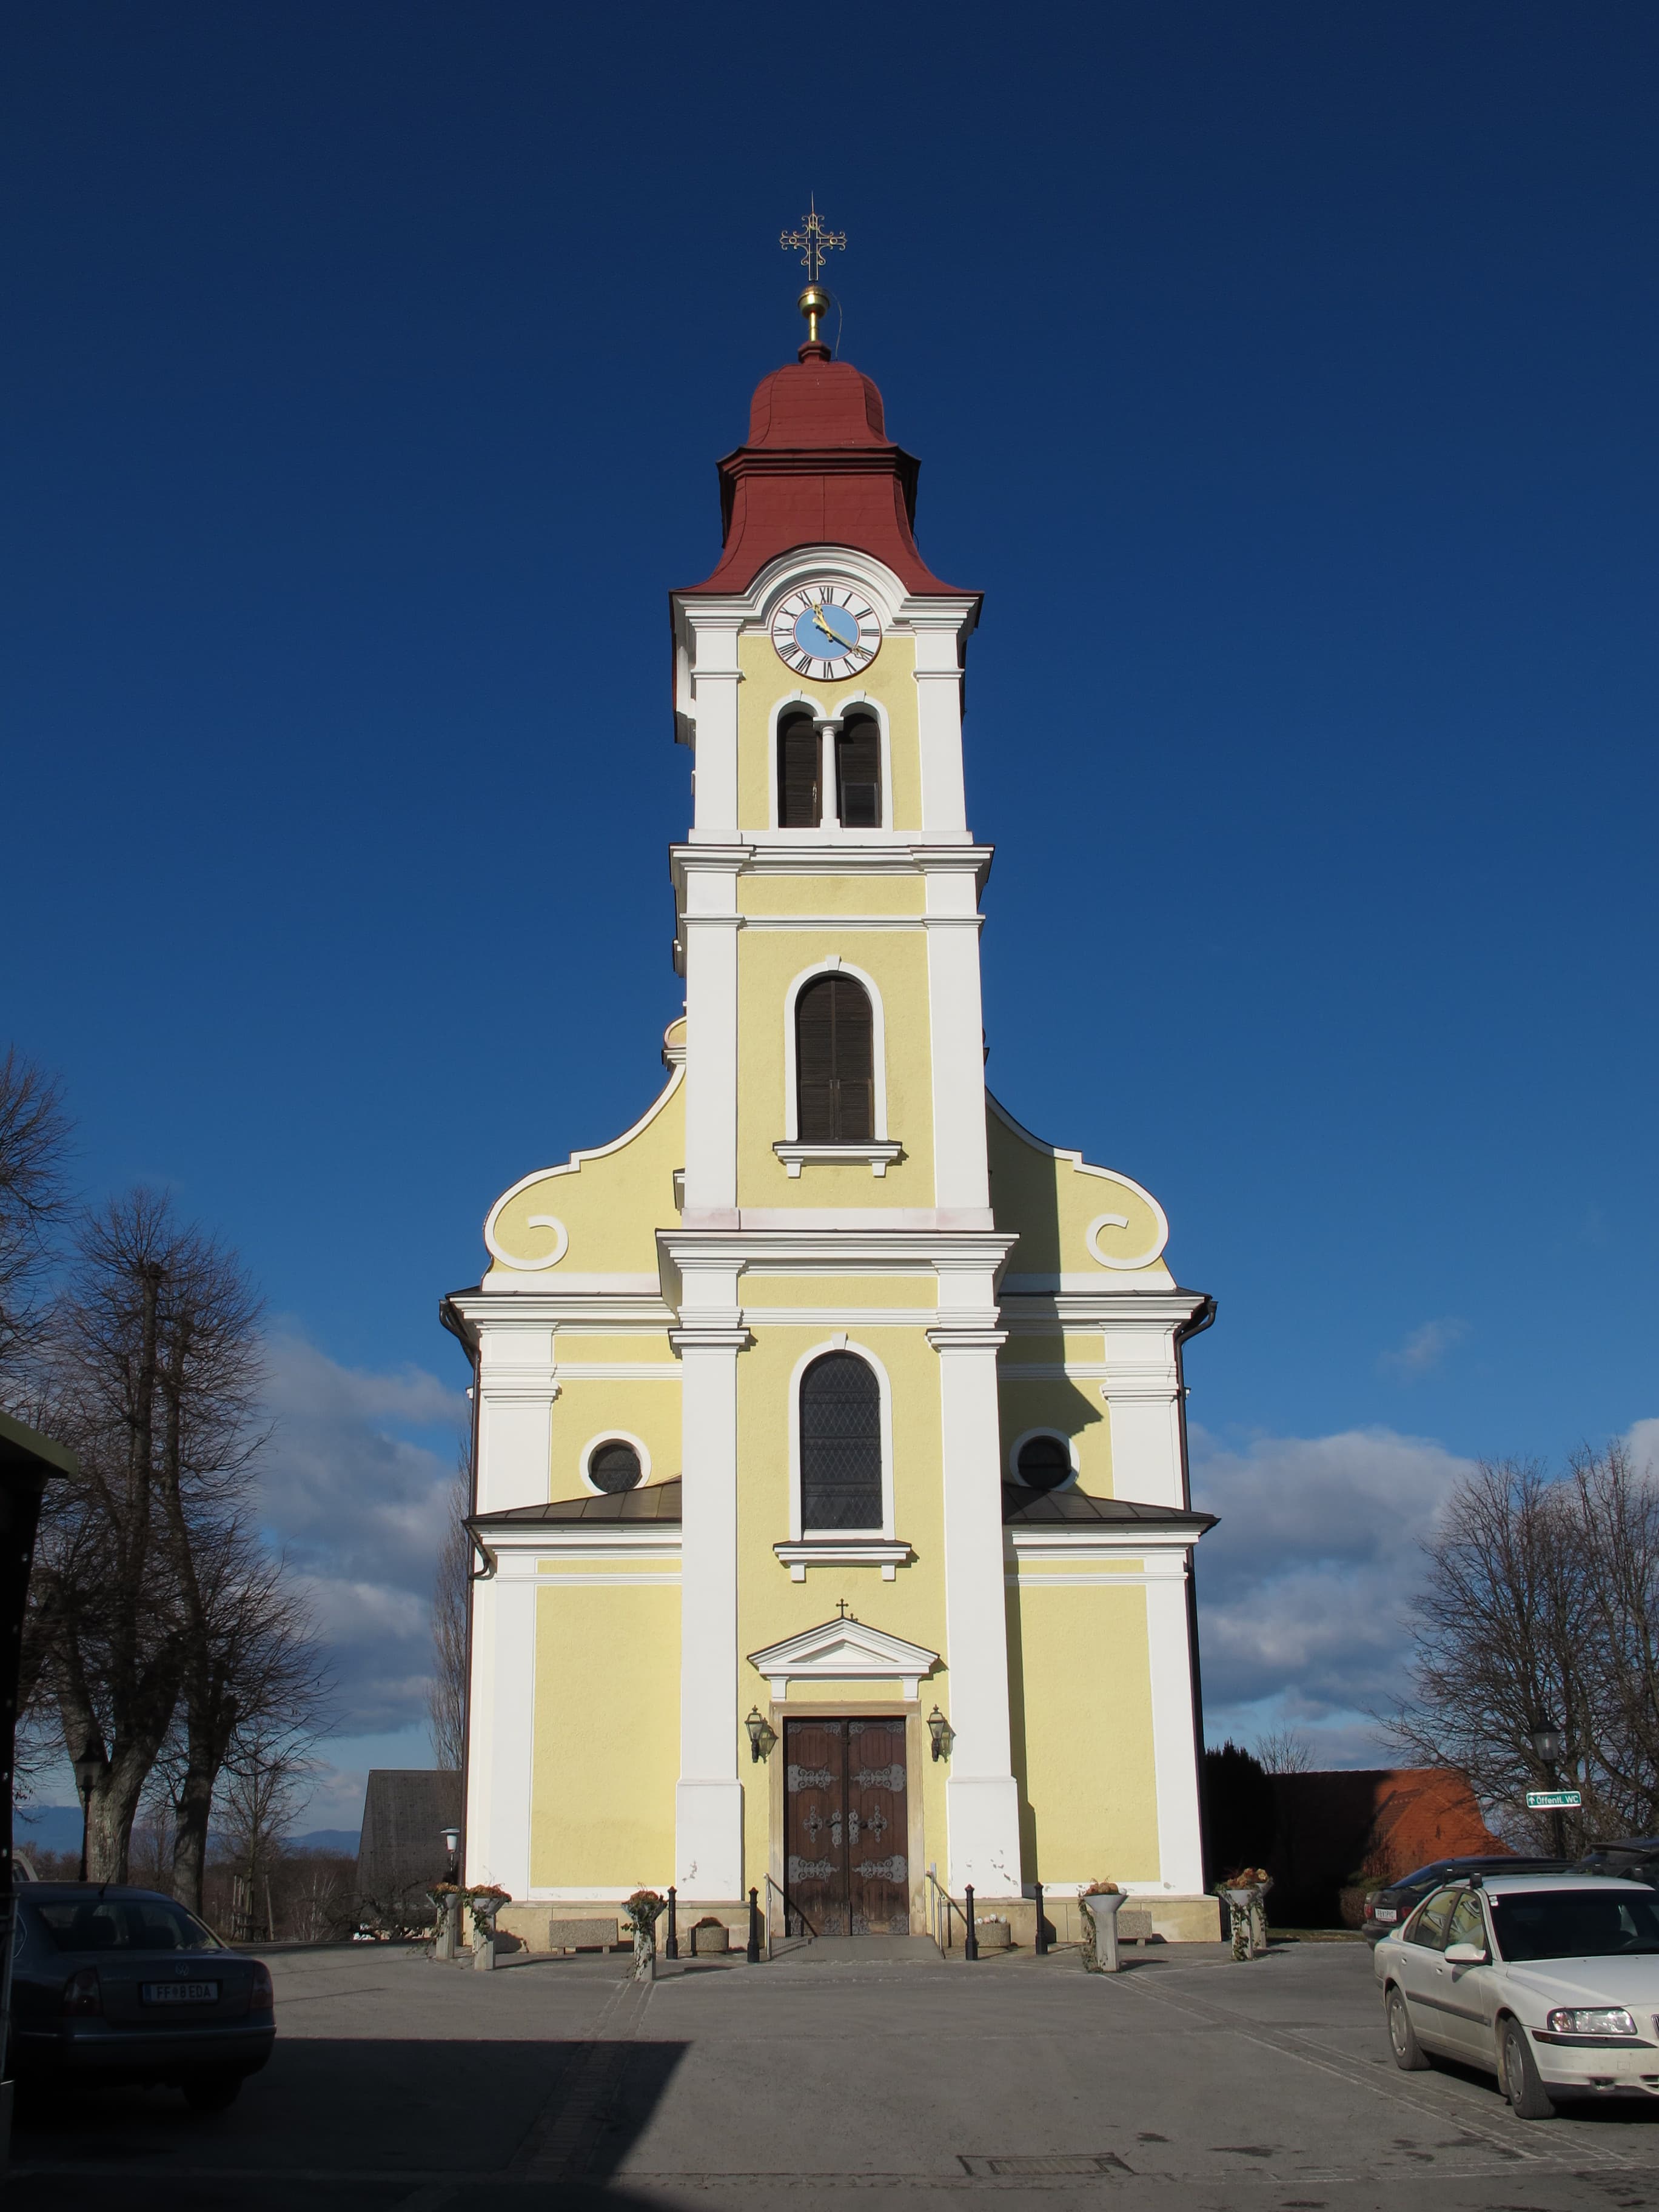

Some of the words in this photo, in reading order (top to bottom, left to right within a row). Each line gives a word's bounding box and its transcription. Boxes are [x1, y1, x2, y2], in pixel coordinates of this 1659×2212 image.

[795, 590, 813, 609] XI
[819, 588, 833, 604] XII
[773, 626, 793, 636] IX
[1536, 1795, 1564, 1805] Öffentl.
